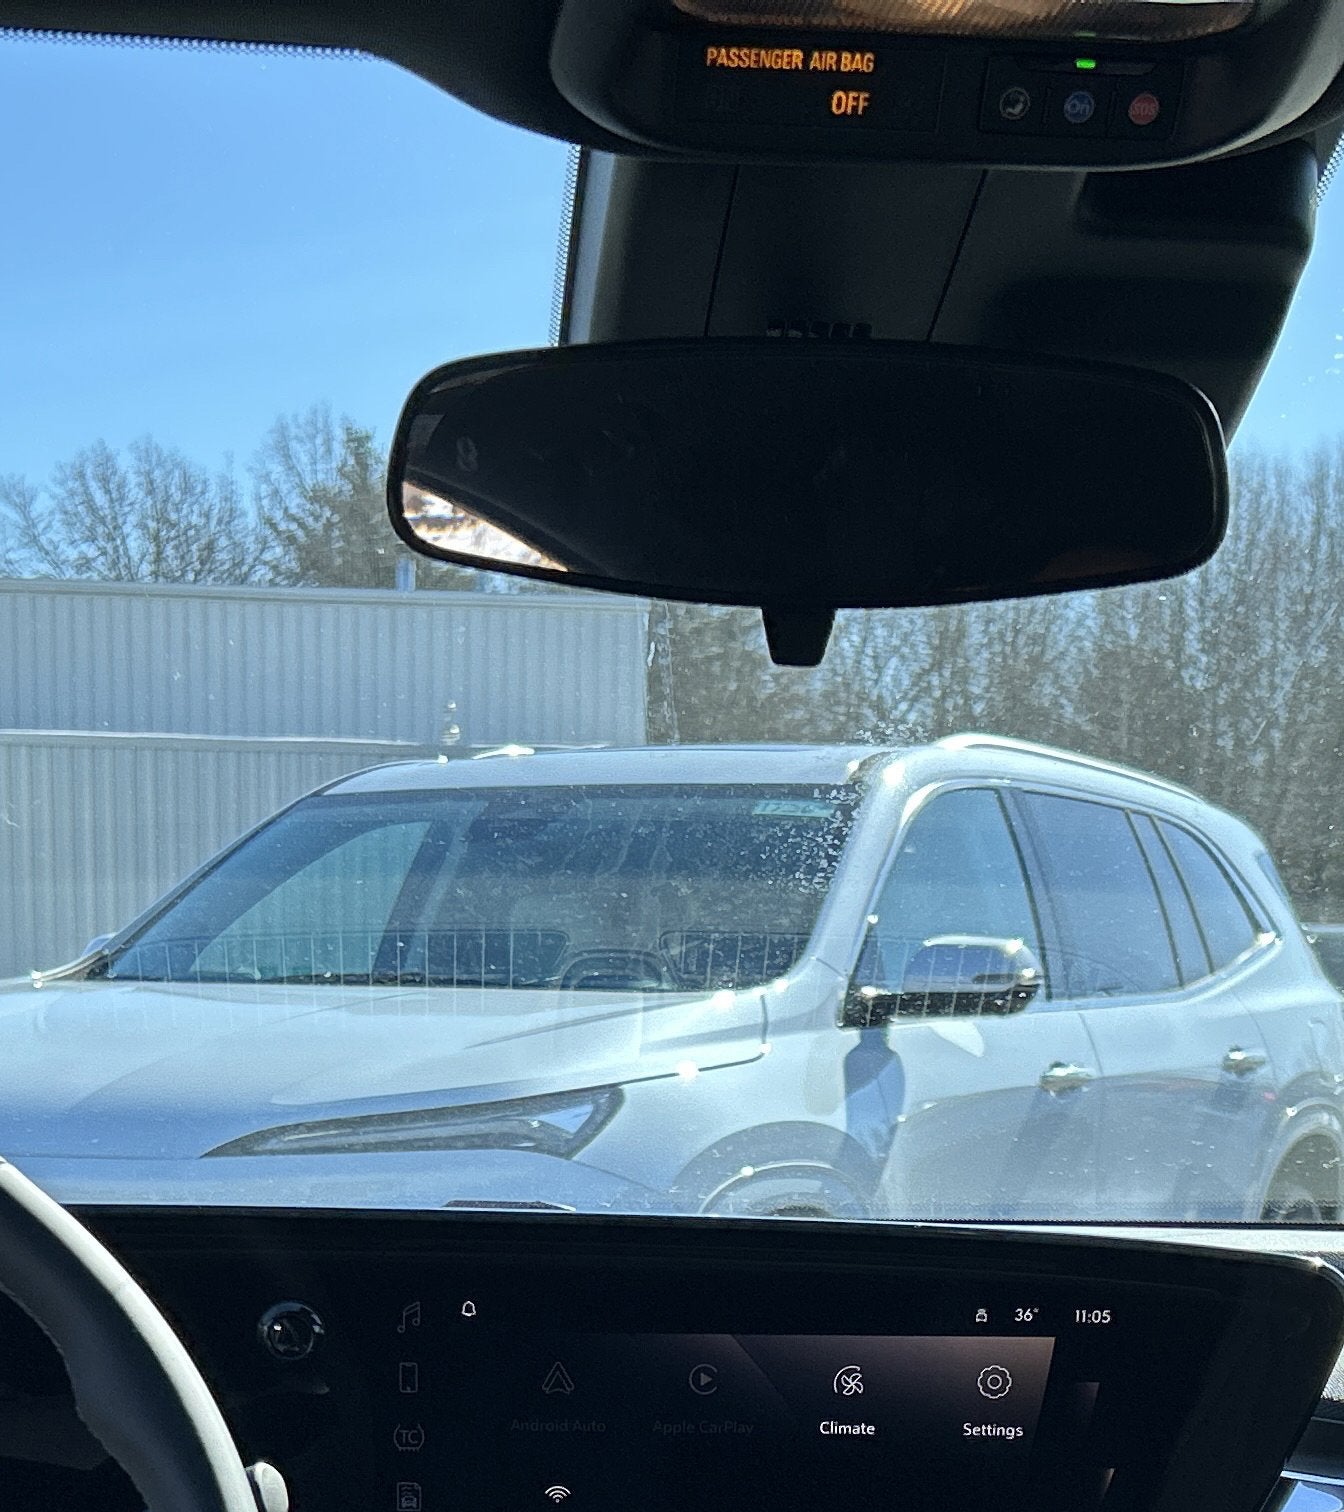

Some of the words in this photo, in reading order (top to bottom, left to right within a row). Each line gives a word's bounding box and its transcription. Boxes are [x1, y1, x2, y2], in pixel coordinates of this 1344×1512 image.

[706, 47, 804, 70] PASSENGER
[810, 51, 837, 71] AIR
[840, 52, 875, 73] BAG
[831, 90, 870, 115] OFF
[1075, 1309, 1111, 1324] 11:05
[511, 1418, 569, 1433] Android
[572, 1418, 606, 1433] Auto
[652, 1419, 695, 1437] Apple
[698, 1419, 755, 1438] CarPlay
[819, 1419, 876, 1437] Climate
[963, 1422, 1024, 1440] Settings
